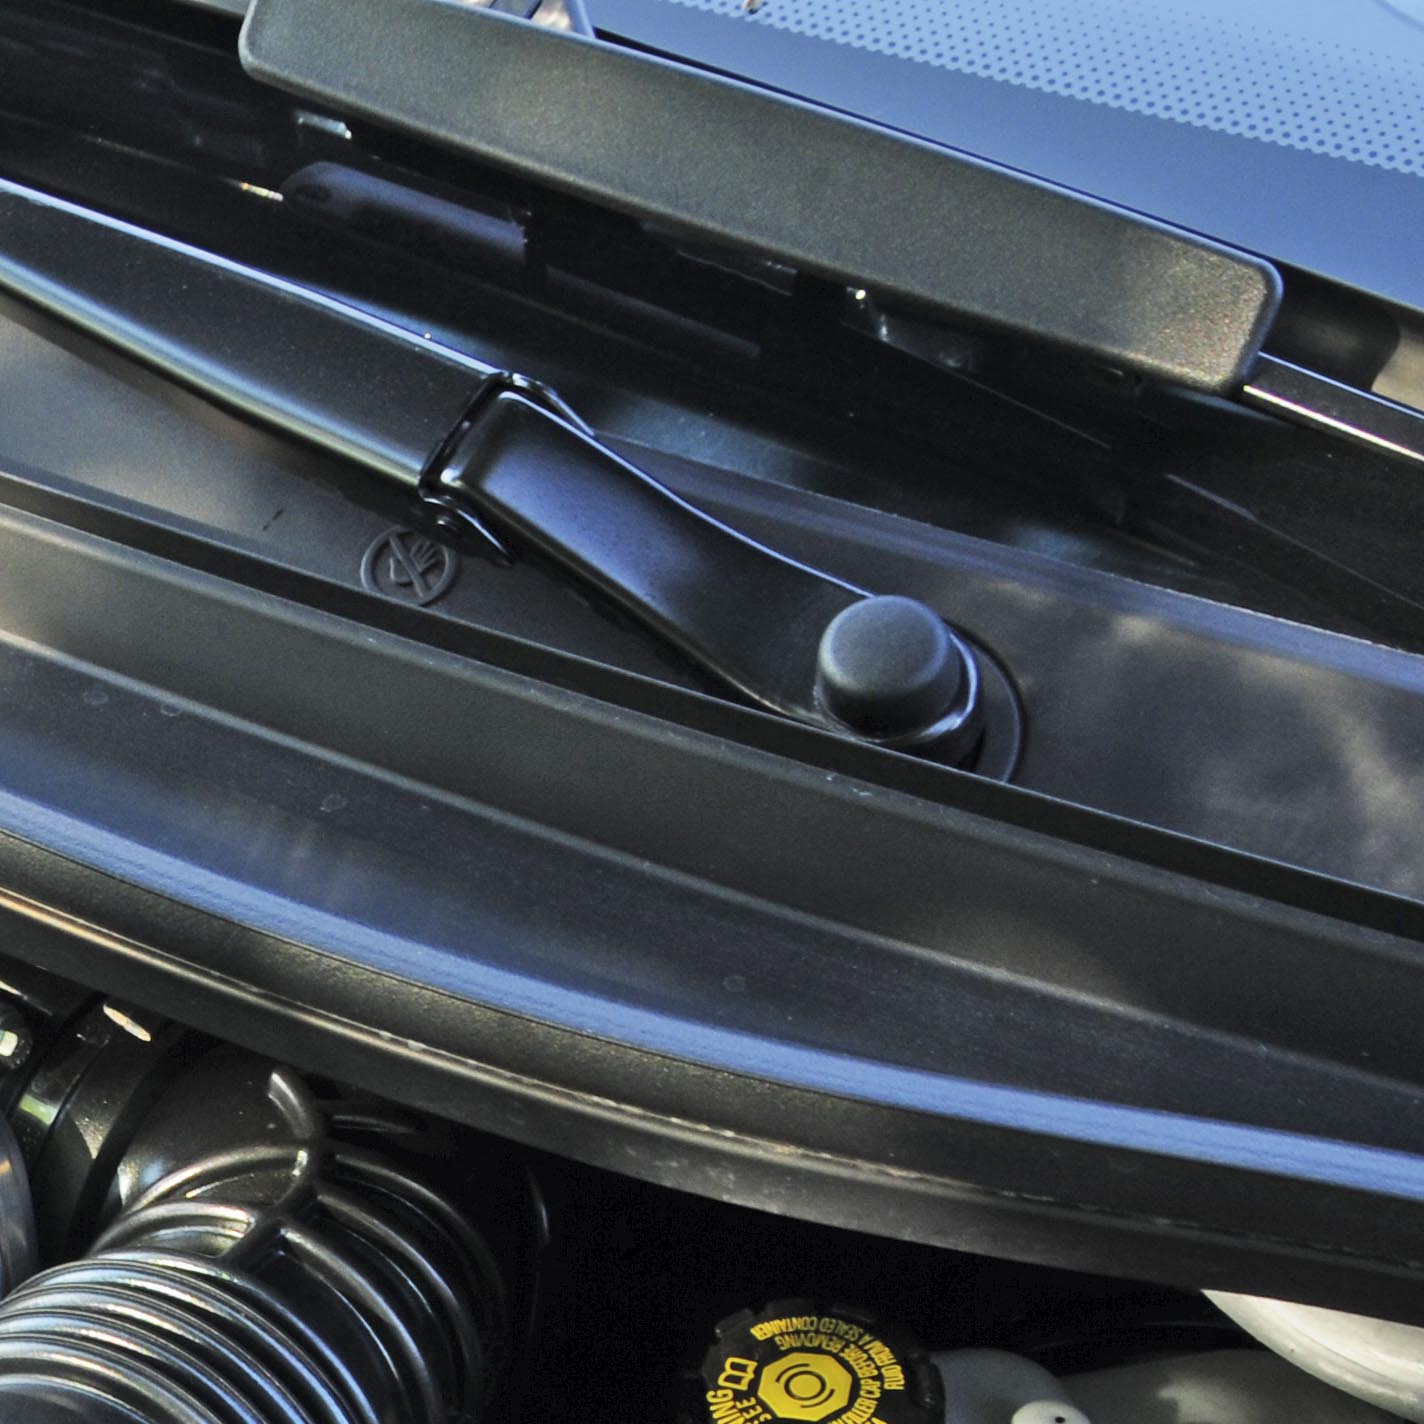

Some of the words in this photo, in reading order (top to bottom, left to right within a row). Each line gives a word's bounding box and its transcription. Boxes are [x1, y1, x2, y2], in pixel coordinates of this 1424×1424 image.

[750, 1316, 818, 1341] CONTAINER
[774, 1332, 846, 1353] REMOVING
[839, 1344, 879, 1378] BEFORE
[860, 1378, 882, 1398] CAP
